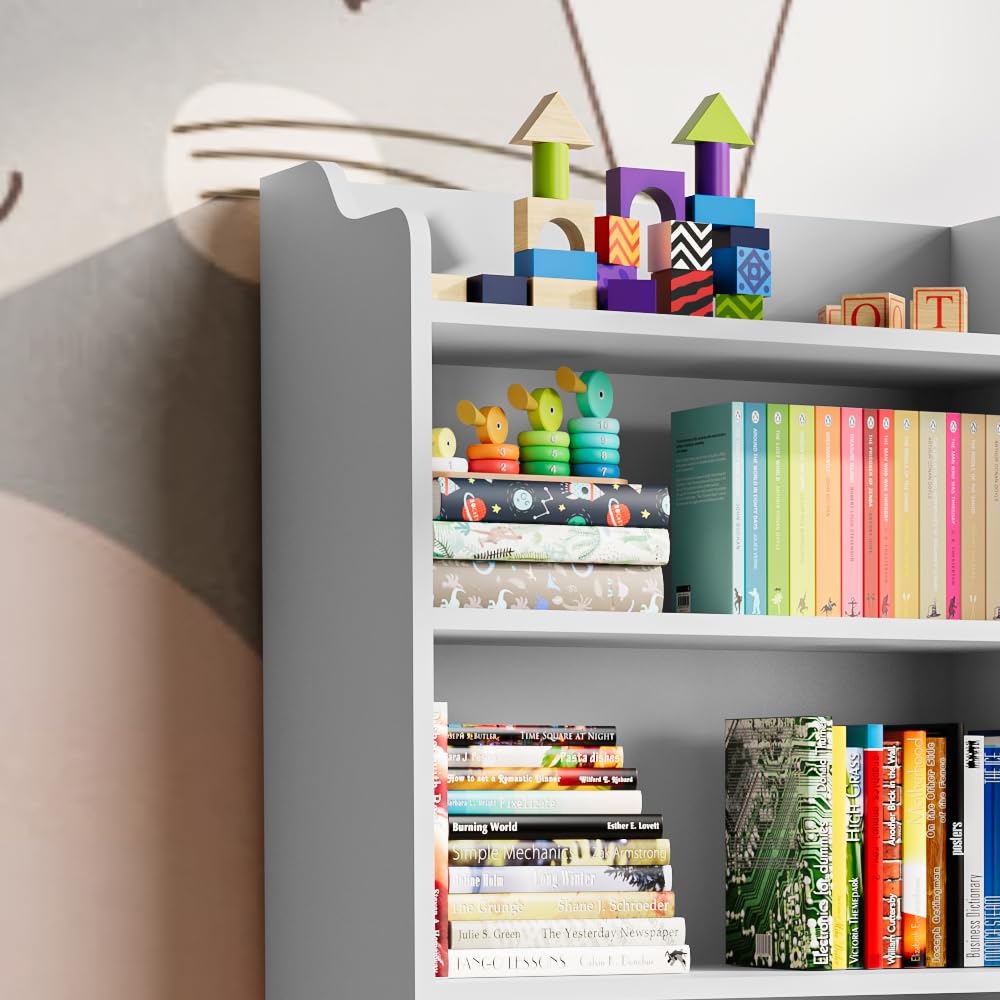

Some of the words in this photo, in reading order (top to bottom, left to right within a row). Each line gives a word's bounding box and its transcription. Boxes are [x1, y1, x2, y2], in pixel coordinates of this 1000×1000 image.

[926, 295, 954, 329] T
[473, 731, 498, 741] BUTLER
[519, 731, 541, 741] TIME
[542, 731, 574, 741] SQUARE
[575, 731, 585, 741] AT
[587, 731, 615, 741] NIGHT
[560, 752, 588, 763] Pasta
[589, 752, 620, 763] dishes
[887, 745, 897, 766] Wall
[926, 742, 936, 767] Side
[466, 775, 475, 784] to
[498, 775, 533, 784] Romantic
[816, 759, 828, 793] Donald
[845, 752, 861, 799] GRASS
[871, 754, 881, 801] graphics
[887, 767, 897, 780] the
[887, 780, 897, 789] in
[926, 769, 936, 802] Other
[887, 789, 897, 812] Brick
[937, 791, 947, 810] the
[871, 805, 881, 839] annual
[926, 803, 936, 821] the
[937, 812, 947, 825] of
[452, 821, 488, 834] Burning
[489, 821, 518, 834] World
[606, 821, 629, 831] Esther
[630, 821, 637, 831] E.
[638, 821, 660, 831] Lovett
[845, 805, 861, 843] HIGH
[887, 812, 897, 847] Another
[926, 823, 936, 840] On
[812, 821, 829, 874] dummies
[950, 821, 965, 857] posters
[452, 845, 499, 864] Simple
[503, 845, 577, 864] Mechanics
[590, 846, 611, 862] Zak
[613, 846, 667, 862] Armstrong
[812, 879, 829, 897] for
[965, 874, 982, 918] Dictionary
[476, 901, 524, 915] Grunge
[557, 898, 594, 912] Shane
[609, 898, 669, 912] Schroeder
[848, 877, 861, 925] THEMEPARK
[458, 929, 480, 941] Julie
[482, 929, 490, 941] S.
[493, 929, 521, 941] Green
[541, 927, 563, 942] The
[563, 927, 616, 942] Yesterday
[619, 927, 679, 942] Newspaper
[812, 899, 829, 966] Electronics
[965, 919, 982, 959] Business
[848, 927, 861, 966] VICTORIA
[887, 934, 897, 966] William
[931, 926, 942, 963] Joseph
